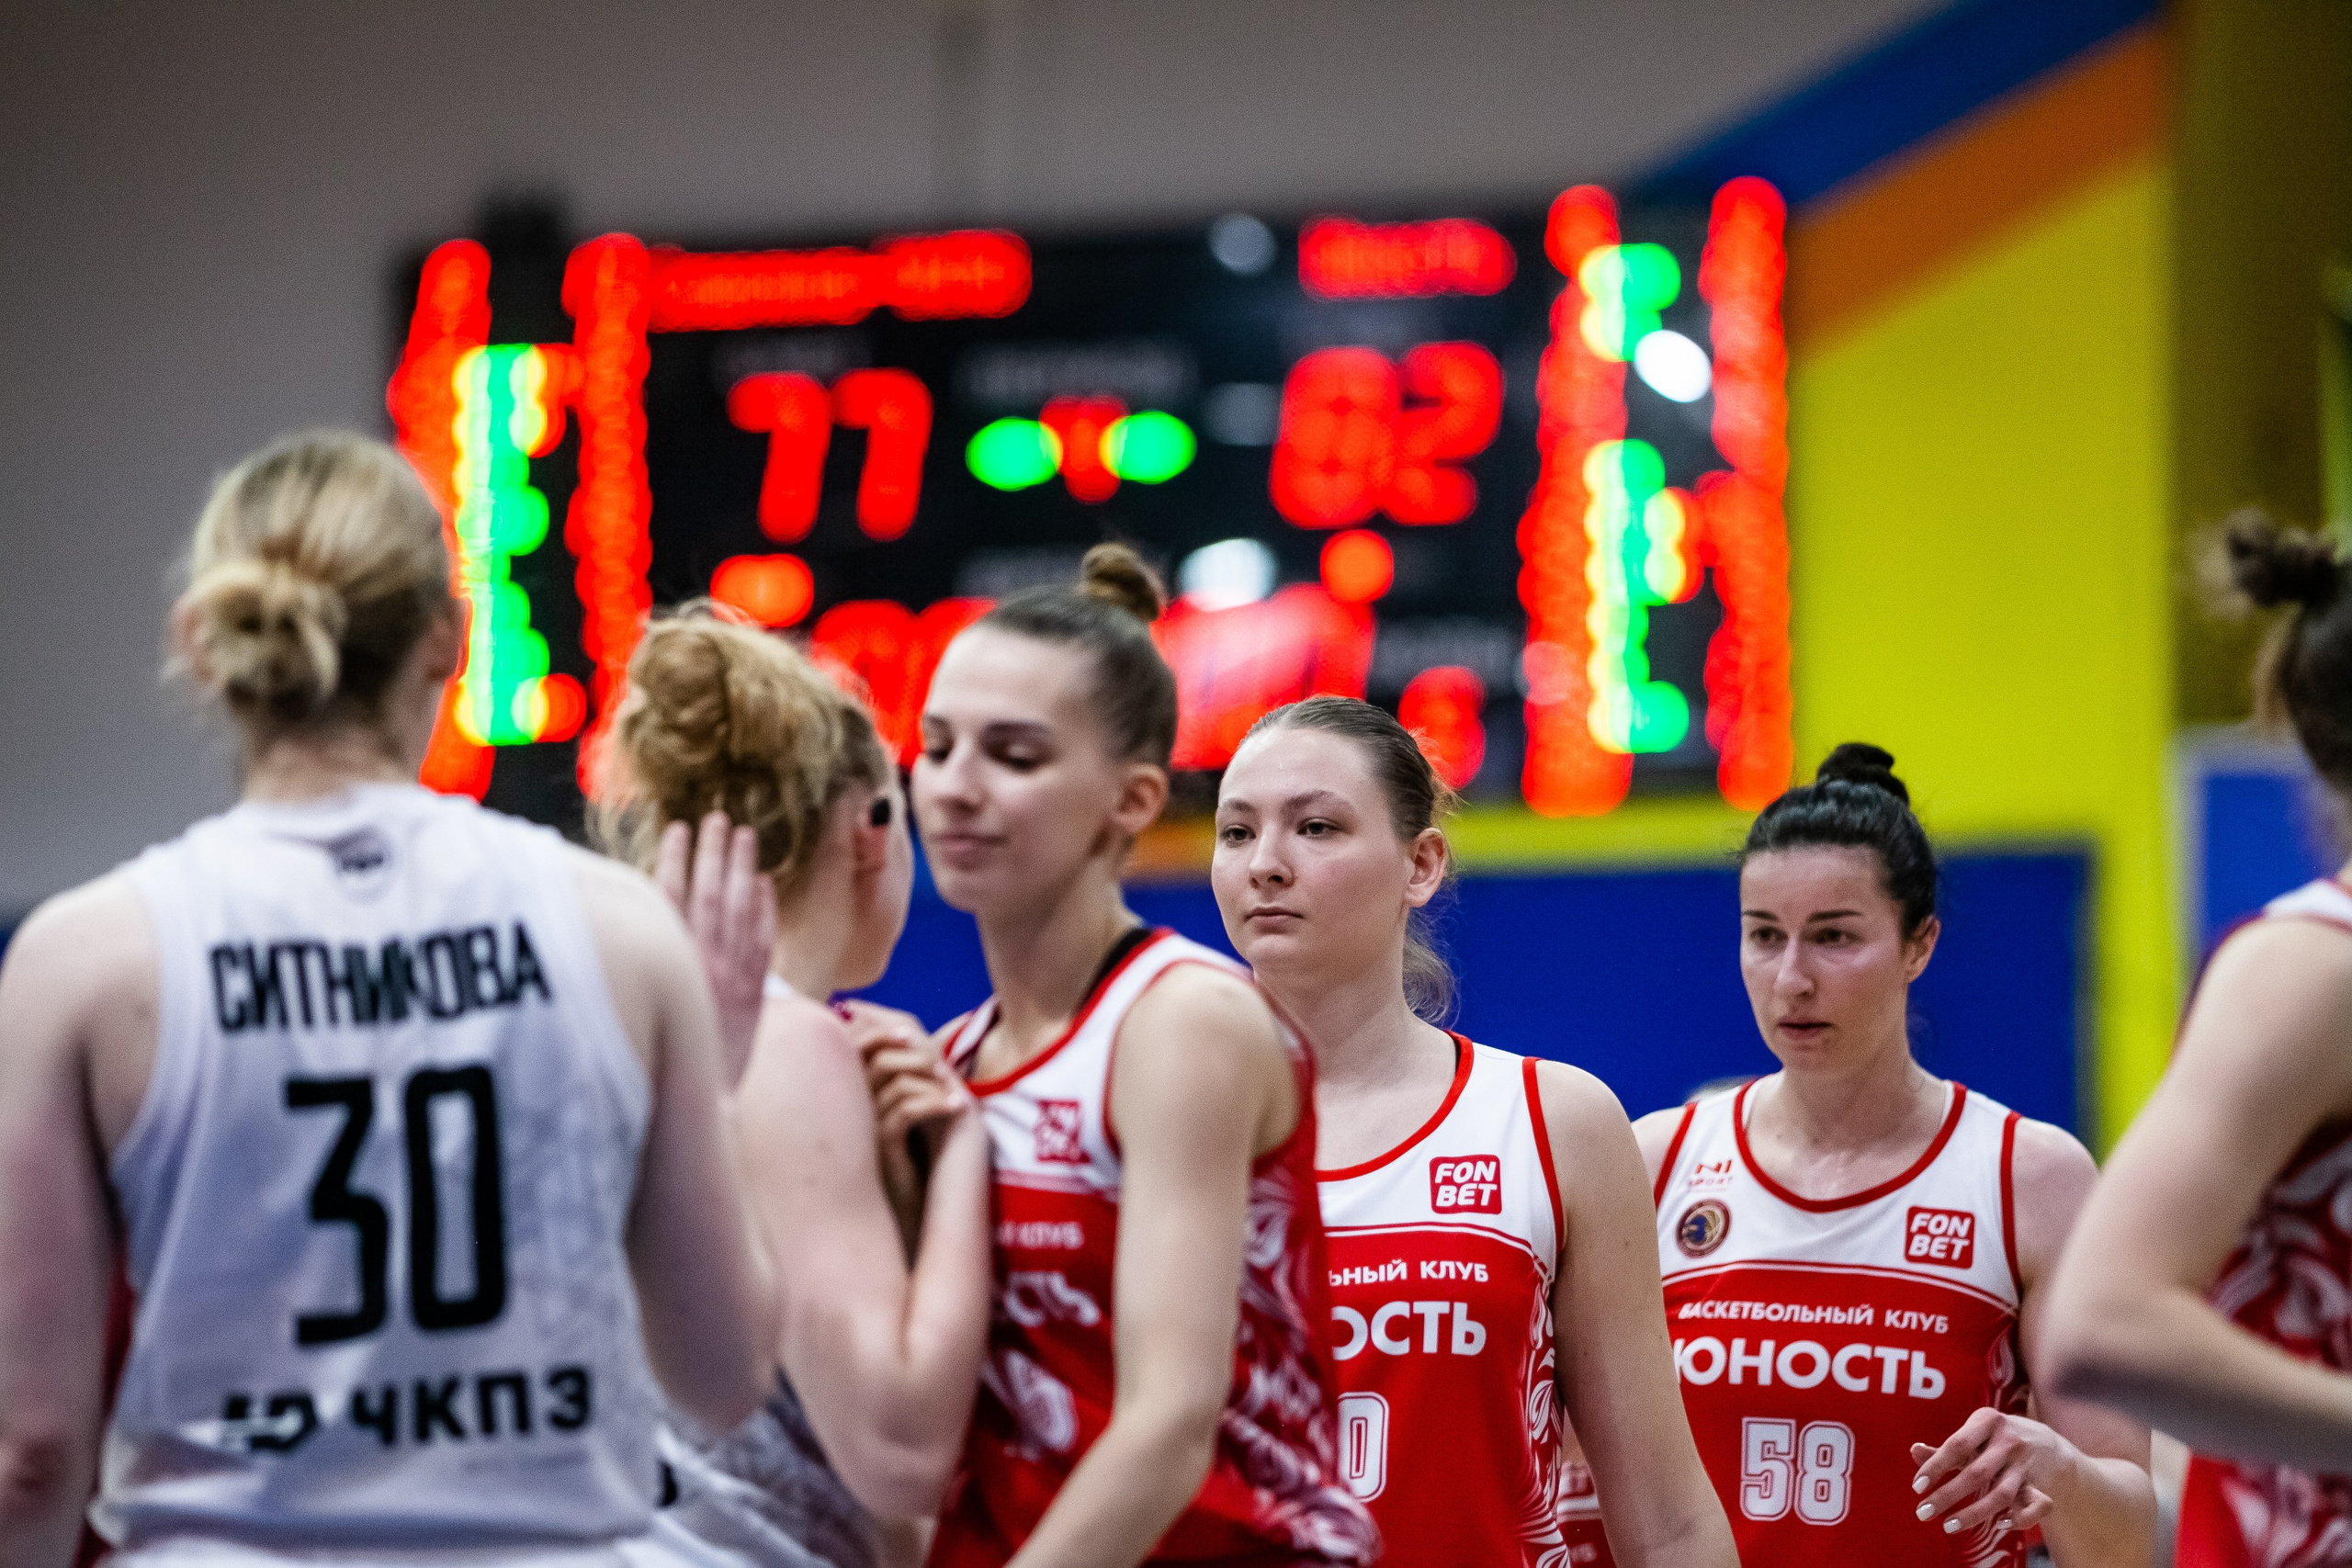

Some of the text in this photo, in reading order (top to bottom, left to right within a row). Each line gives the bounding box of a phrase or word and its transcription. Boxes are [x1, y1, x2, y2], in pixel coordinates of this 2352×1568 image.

[1269, 341, 1503, 529] 82
[1434, 1161, 1498, 1184] FON
[283, 1063, 508, 1347] 30
[1435, 1183, 1498, 1207] BET
[1910, 1212, 1972, 1238] FON
[1908, 1234, 1970, 1261] BET
[1419, 1260, 1489, 1283] КЛУБ
[1884, 1309, 1950, 1334] КЛУБ
[1673, 1336, 1947, 1400] ЮНОСТЬ
[350, 1365, 593, 1448] ЧКПЗ
[1739, 1416, 1856, 1527] 58
